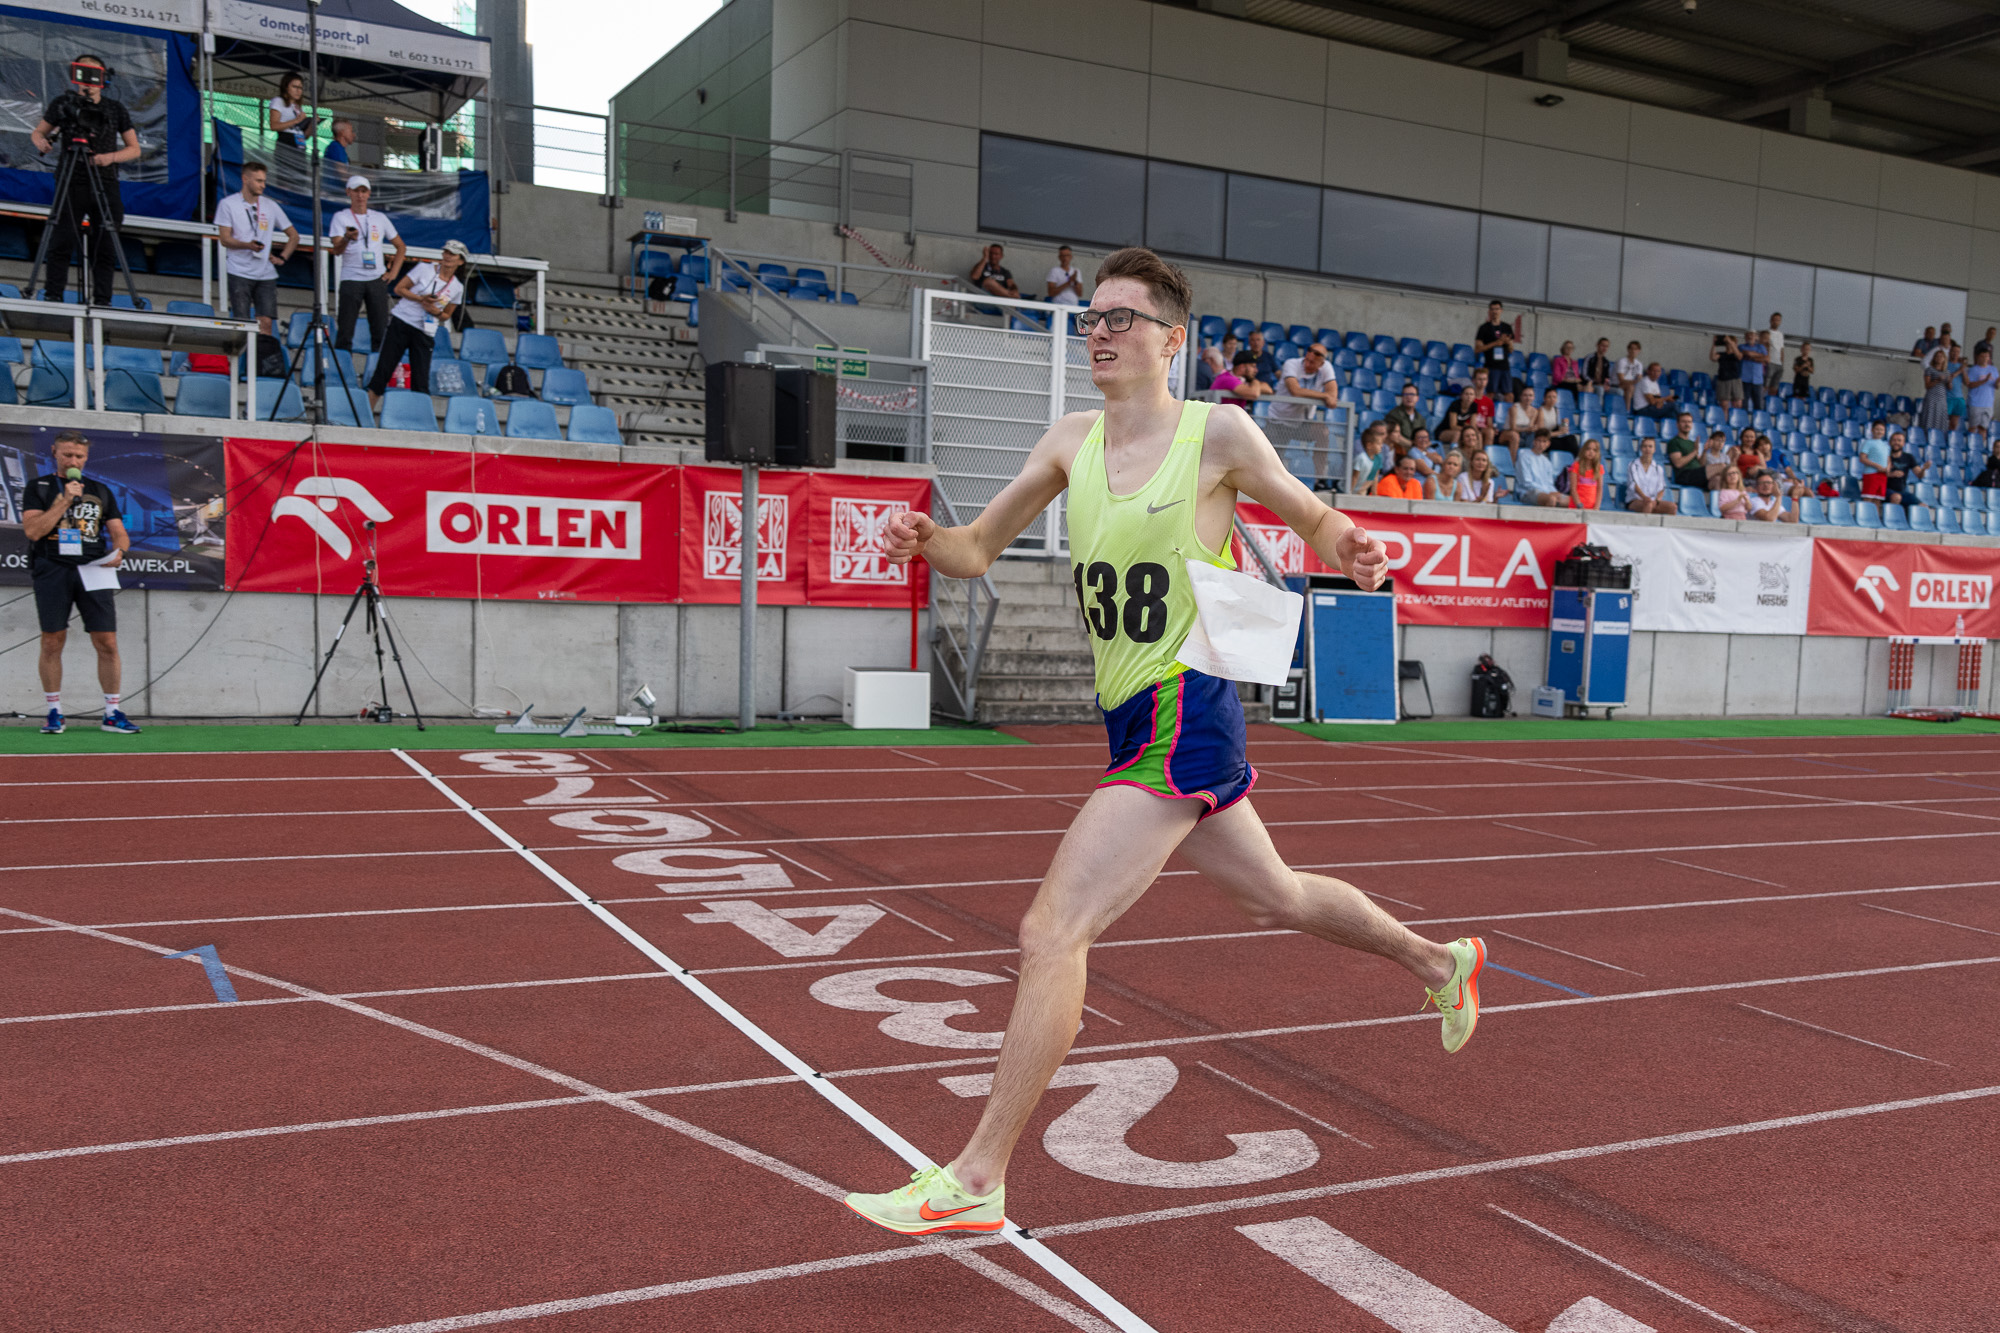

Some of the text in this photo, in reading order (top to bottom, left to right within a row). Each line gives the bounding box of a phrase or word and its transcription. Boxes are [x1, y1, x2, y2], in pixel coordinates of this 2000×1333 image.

[104, 3, 127, 15] 602
[130, 7, 155, 20] 314
[158, 11, 181, 23] 171
[259, 16, 369, 45] domtelsport.pl
[408, 52, 429, 63] 602
[431, 56, 452, 67] 314
[454, 59, 474, 70] 171
[440, 502, 627, 549] ORLEN
[835, 555, 904, 580] PZLA
[1073, 561, 1170, 644] 138
[1456, 595, 1500, 608] LEKKIEJ
[1501, 596, 1549, 609] ATLETYKI
[1916, 578, 1987, 604] ORLEN
[458, 751, 590, 774] 8
[522, 776, 659, 805] 7
[548, 809, 713, 843] 6
[611, 848, 795, 894] 5
[682, 900, 889, 958] 4
[808, 966, 1085, 1050] 3
[938, 1056, 1321, 1189] 2
